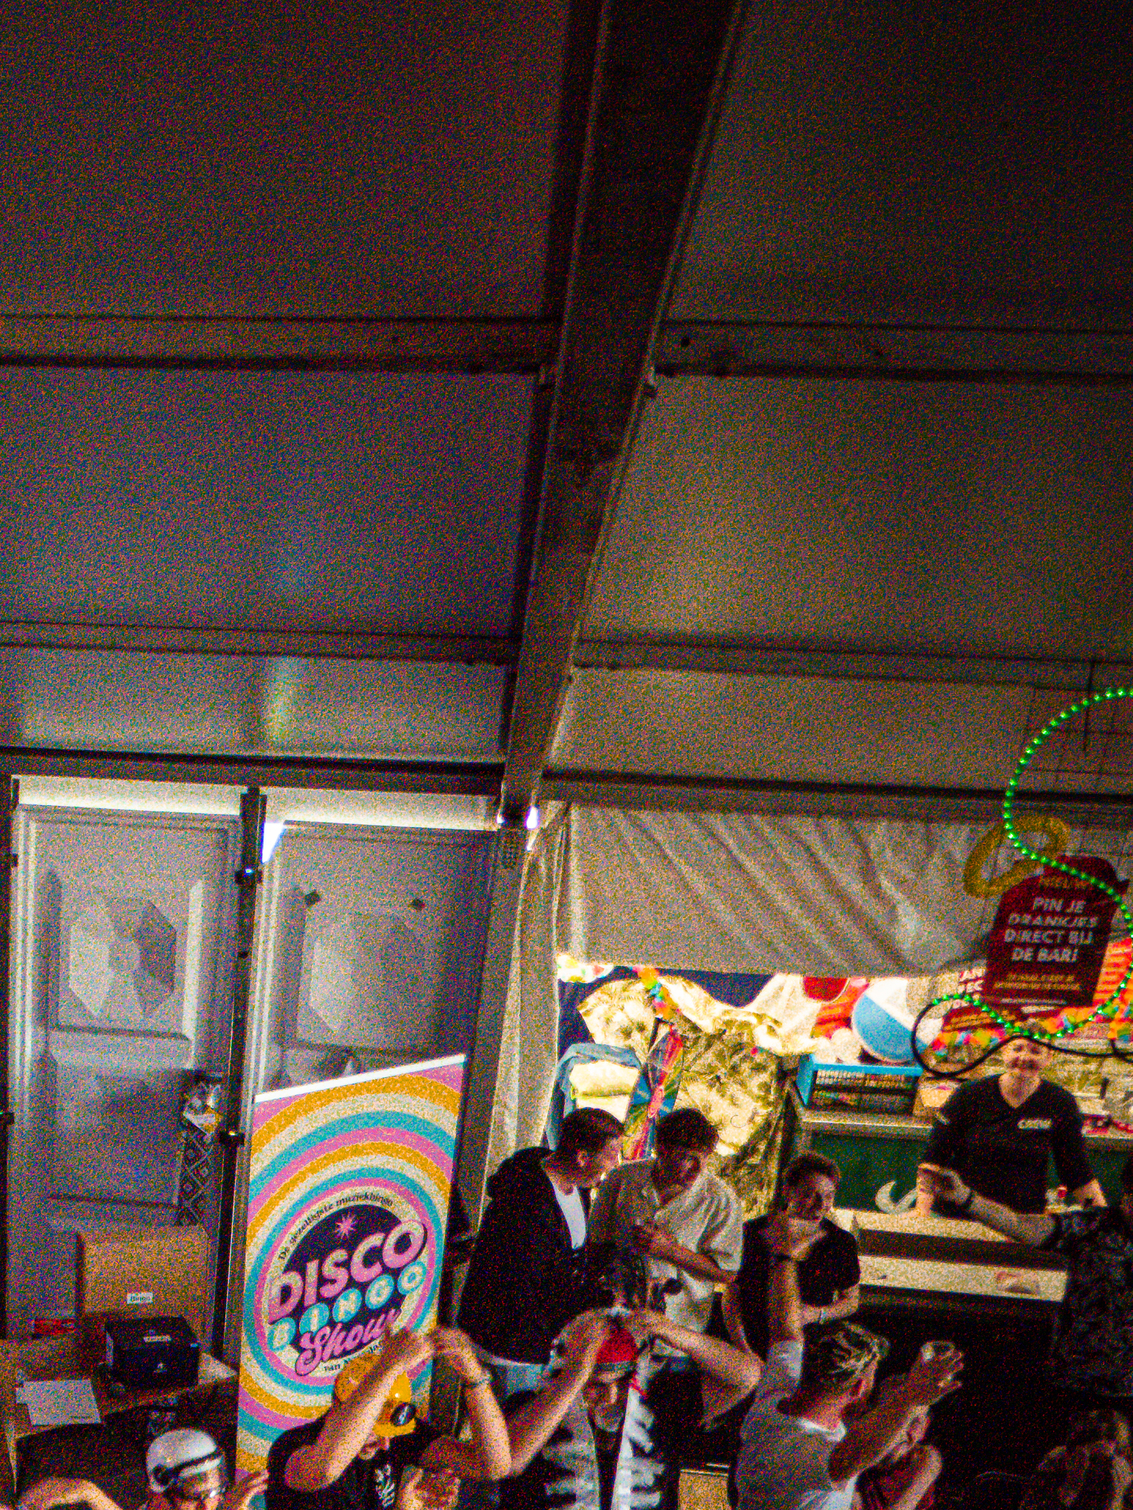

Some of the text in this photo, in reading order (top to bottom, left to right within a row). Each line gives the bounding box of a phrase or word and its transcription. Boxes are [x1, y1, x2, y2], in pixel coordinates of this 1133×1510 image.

[1008, 912, 1100, 928] DRANKJES
[1032, 896, 1087, 913] PIN JE
[1004, 928, 1094, 945] DIRECT BIJ
[1011, 947, 1079, 963] DE BAR!
[279, 1192, 395, 1260] De gezelligste muziekbingo
[268, 1218, 427, 1325] DISCO
[268, 1262, 426, 1350] BINGO
[295, 1304, 403, 1377] Show
